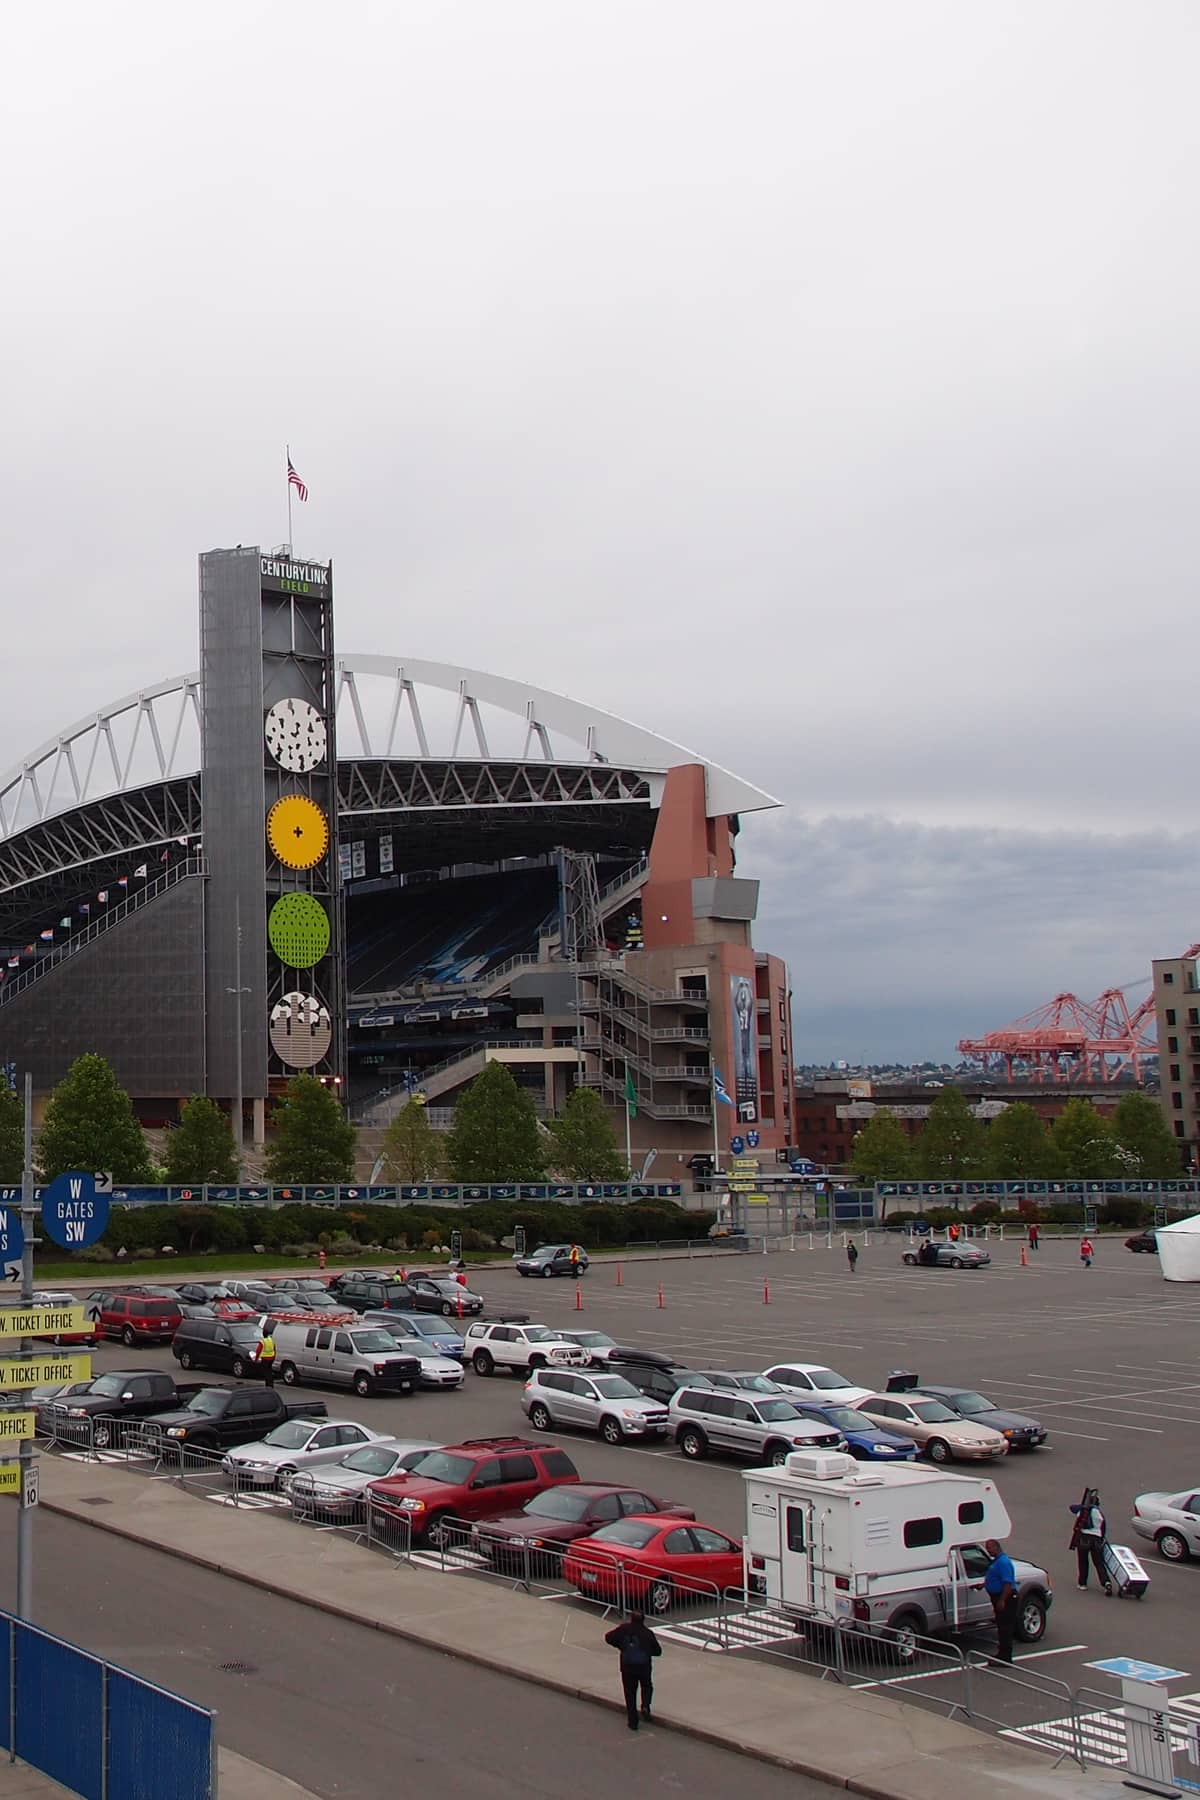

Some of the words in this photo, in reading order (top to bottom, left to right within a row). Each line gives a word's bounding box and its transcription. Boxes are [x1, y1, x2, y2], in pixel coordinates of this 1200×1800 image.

[261, 559, 328, 585] CENTURYLINK
[281, 579, 309, 593] FIELD
[2, 1189, 16, 1199] OF
[70, 1178, 82, 1199] W
[57, 1202, 94, 1218] GATES
[65, 1221, 85, 1242] SW
[11, 1315, 41, 1331] TICKET
[44, 1313, 73, 1329] OFFICE
[11, 1366, 40, 1383] TICKET
[44, 1364, 73, 1381] OFFICE
[27, 1488, 36, 1505] 10
